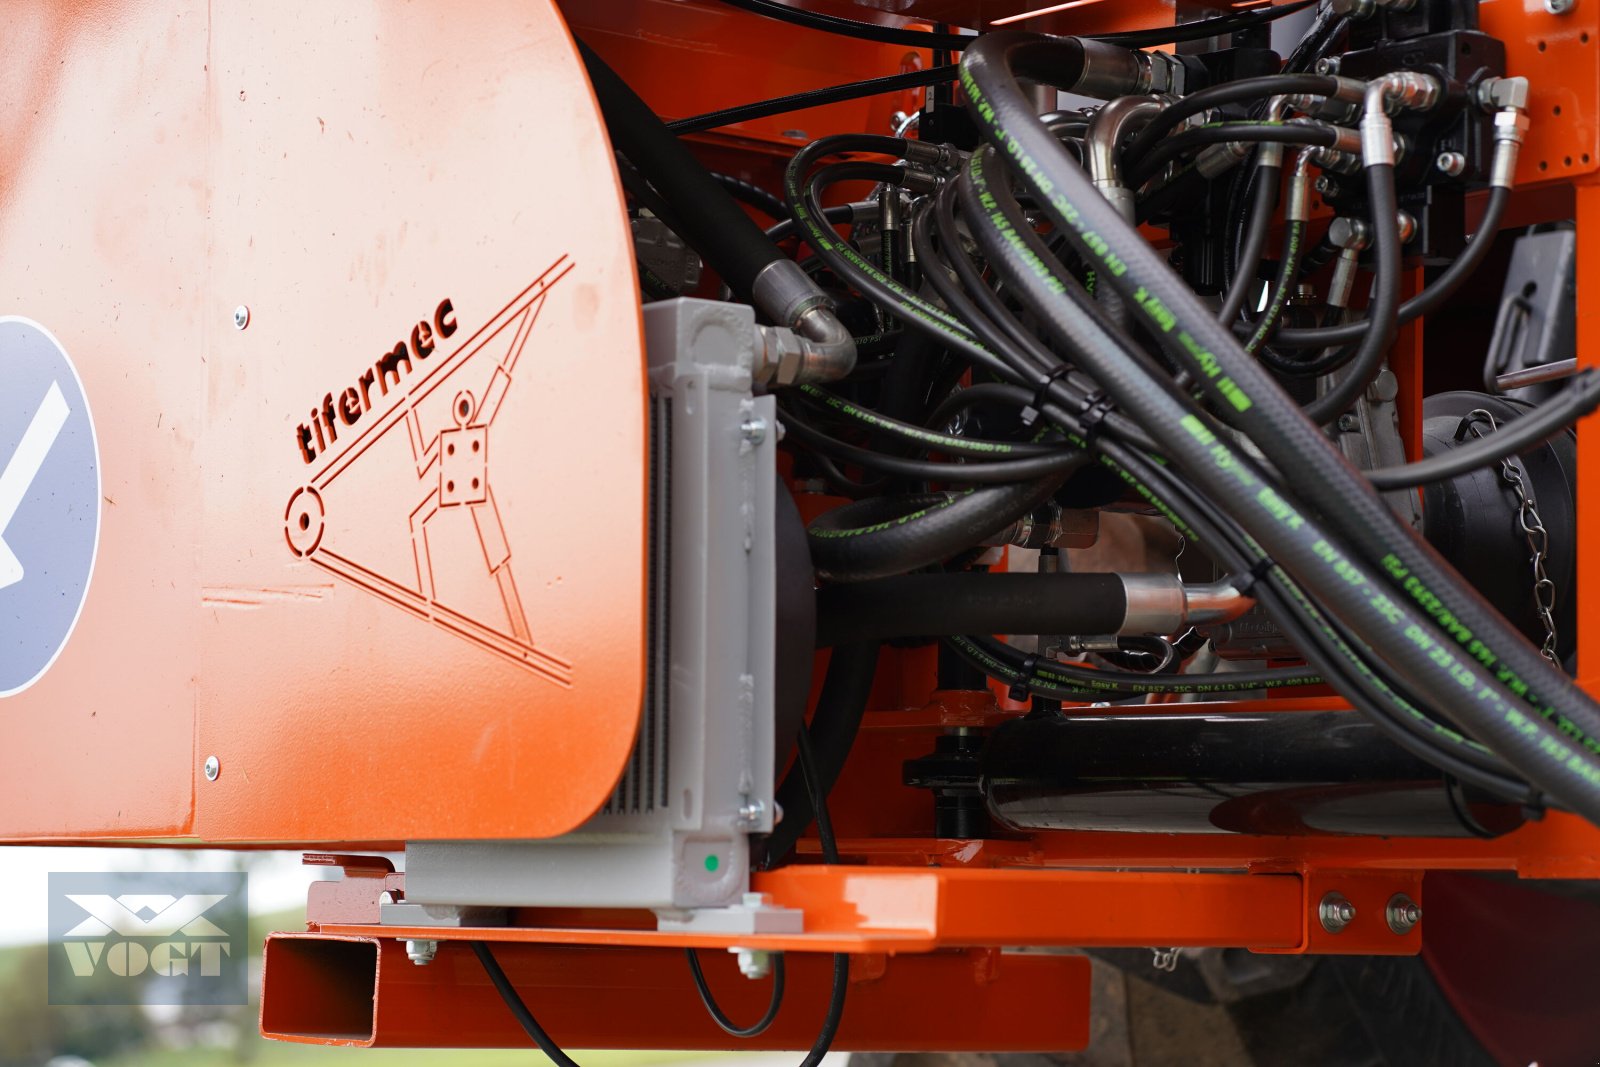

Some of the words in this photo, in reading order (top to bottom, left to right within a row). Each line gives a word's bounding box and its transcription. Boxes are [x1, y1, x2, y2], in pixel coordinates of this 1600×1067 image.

[1103, 253, 1127, 277] EN
[297, 298, 458, 464] tifermec
[1132, 683, 1145, 692] EN
